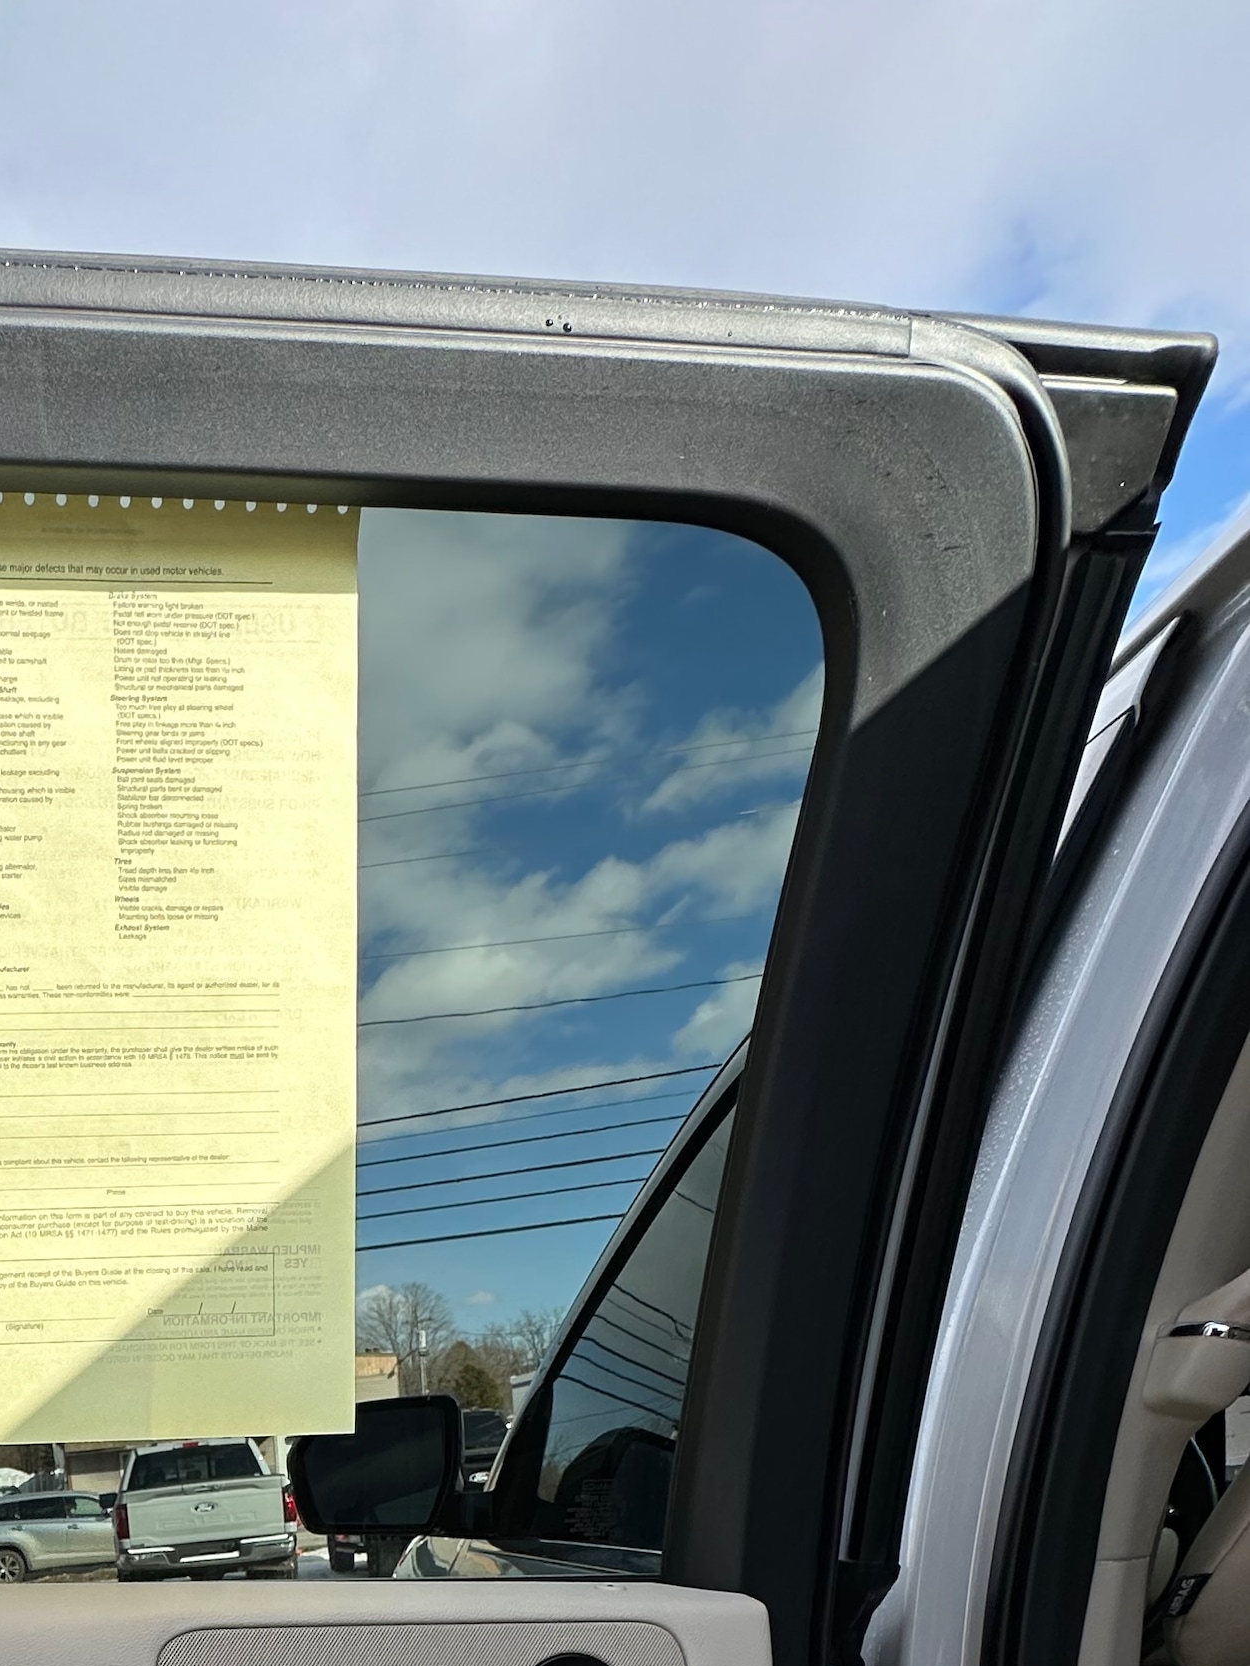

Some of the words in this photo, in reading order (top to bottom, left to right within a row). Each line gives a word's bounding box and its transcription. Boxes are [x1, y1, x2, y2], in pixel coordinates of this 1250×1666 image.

[9, 562, 32, 574] major
[34, 562, 65, 573] defects
[67, 563, 84, 574] that
[85, 565, 103, 576] may
[105, 566, 128, 575] occur
[129, 565, 138, 575] in
[139, 565, 161, 575] used
[162, 565, 186, 575] motor
[188, 566, 225, 576] vehicles.
